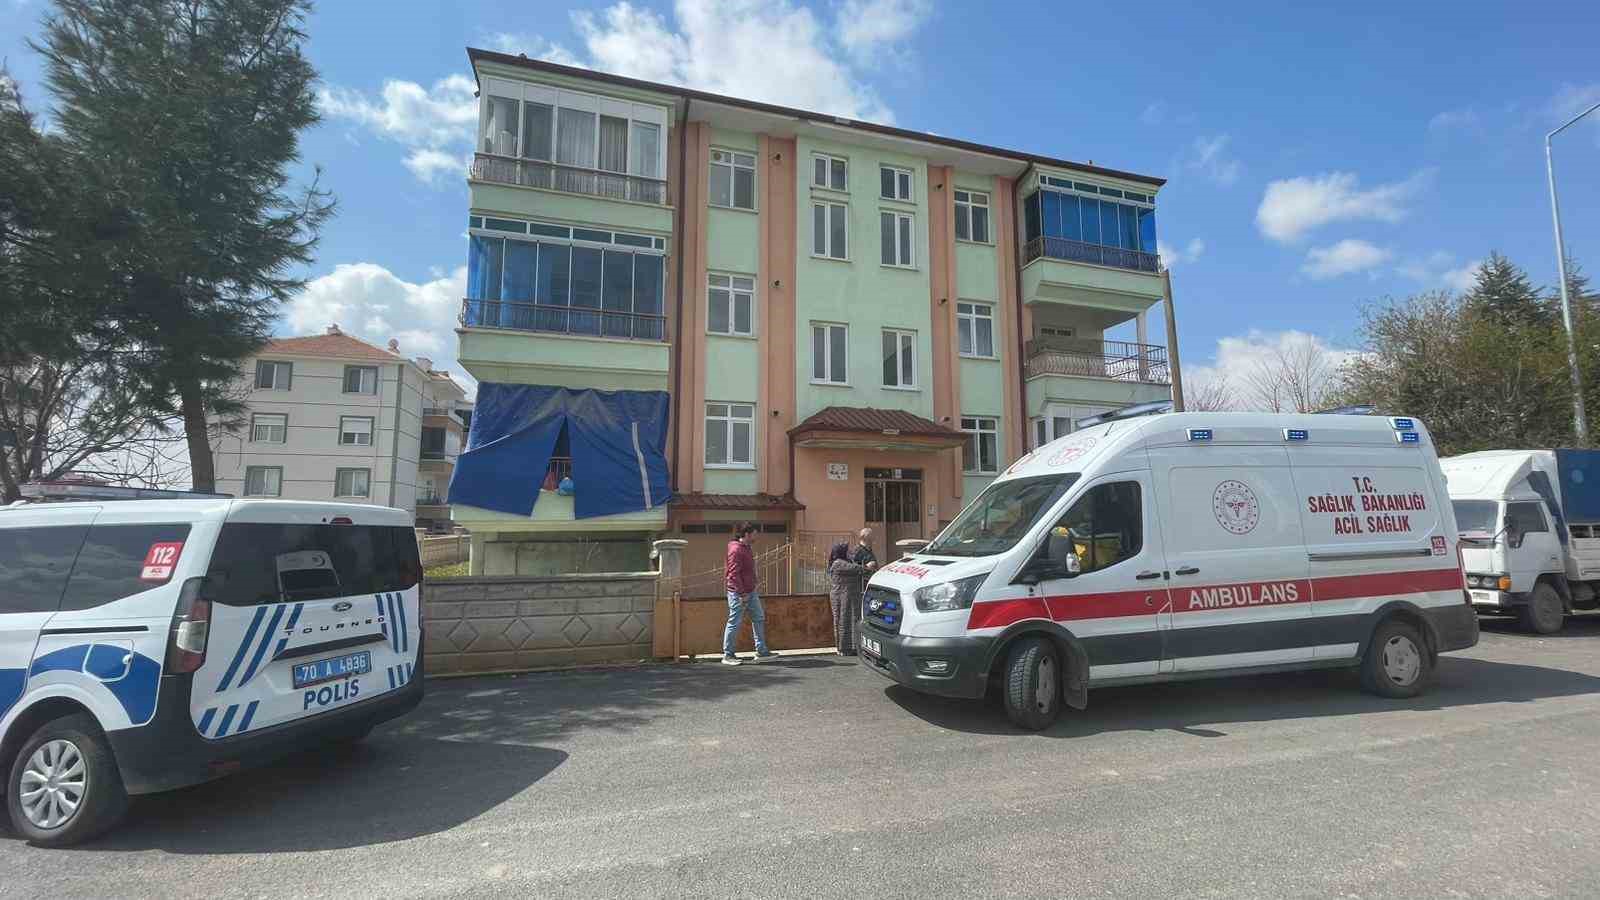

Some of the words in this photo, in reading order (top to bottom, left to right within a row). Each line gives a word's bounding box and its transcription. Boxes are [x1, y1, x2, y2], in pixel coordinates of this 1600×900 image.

[1352, 476, 1377, 493] T.C.
[1308, 493, 1356, 513] SAĞLIK
[1360, 492, 1426, 511] BAKANLIĞI
[1334, 514, 1363, 534] ACİL
[1368, 513, 1412, 533] SAĞLIK
[151, 546, 176, 564] 112
[1189, 583, 1299, 609] AMBULANS
[284, 616, 385, 636] TOURNEO
[302, 665, 317, 681] 70
[326, 661, 333, 676] A
[304, 678, 360, 710] POLİS
